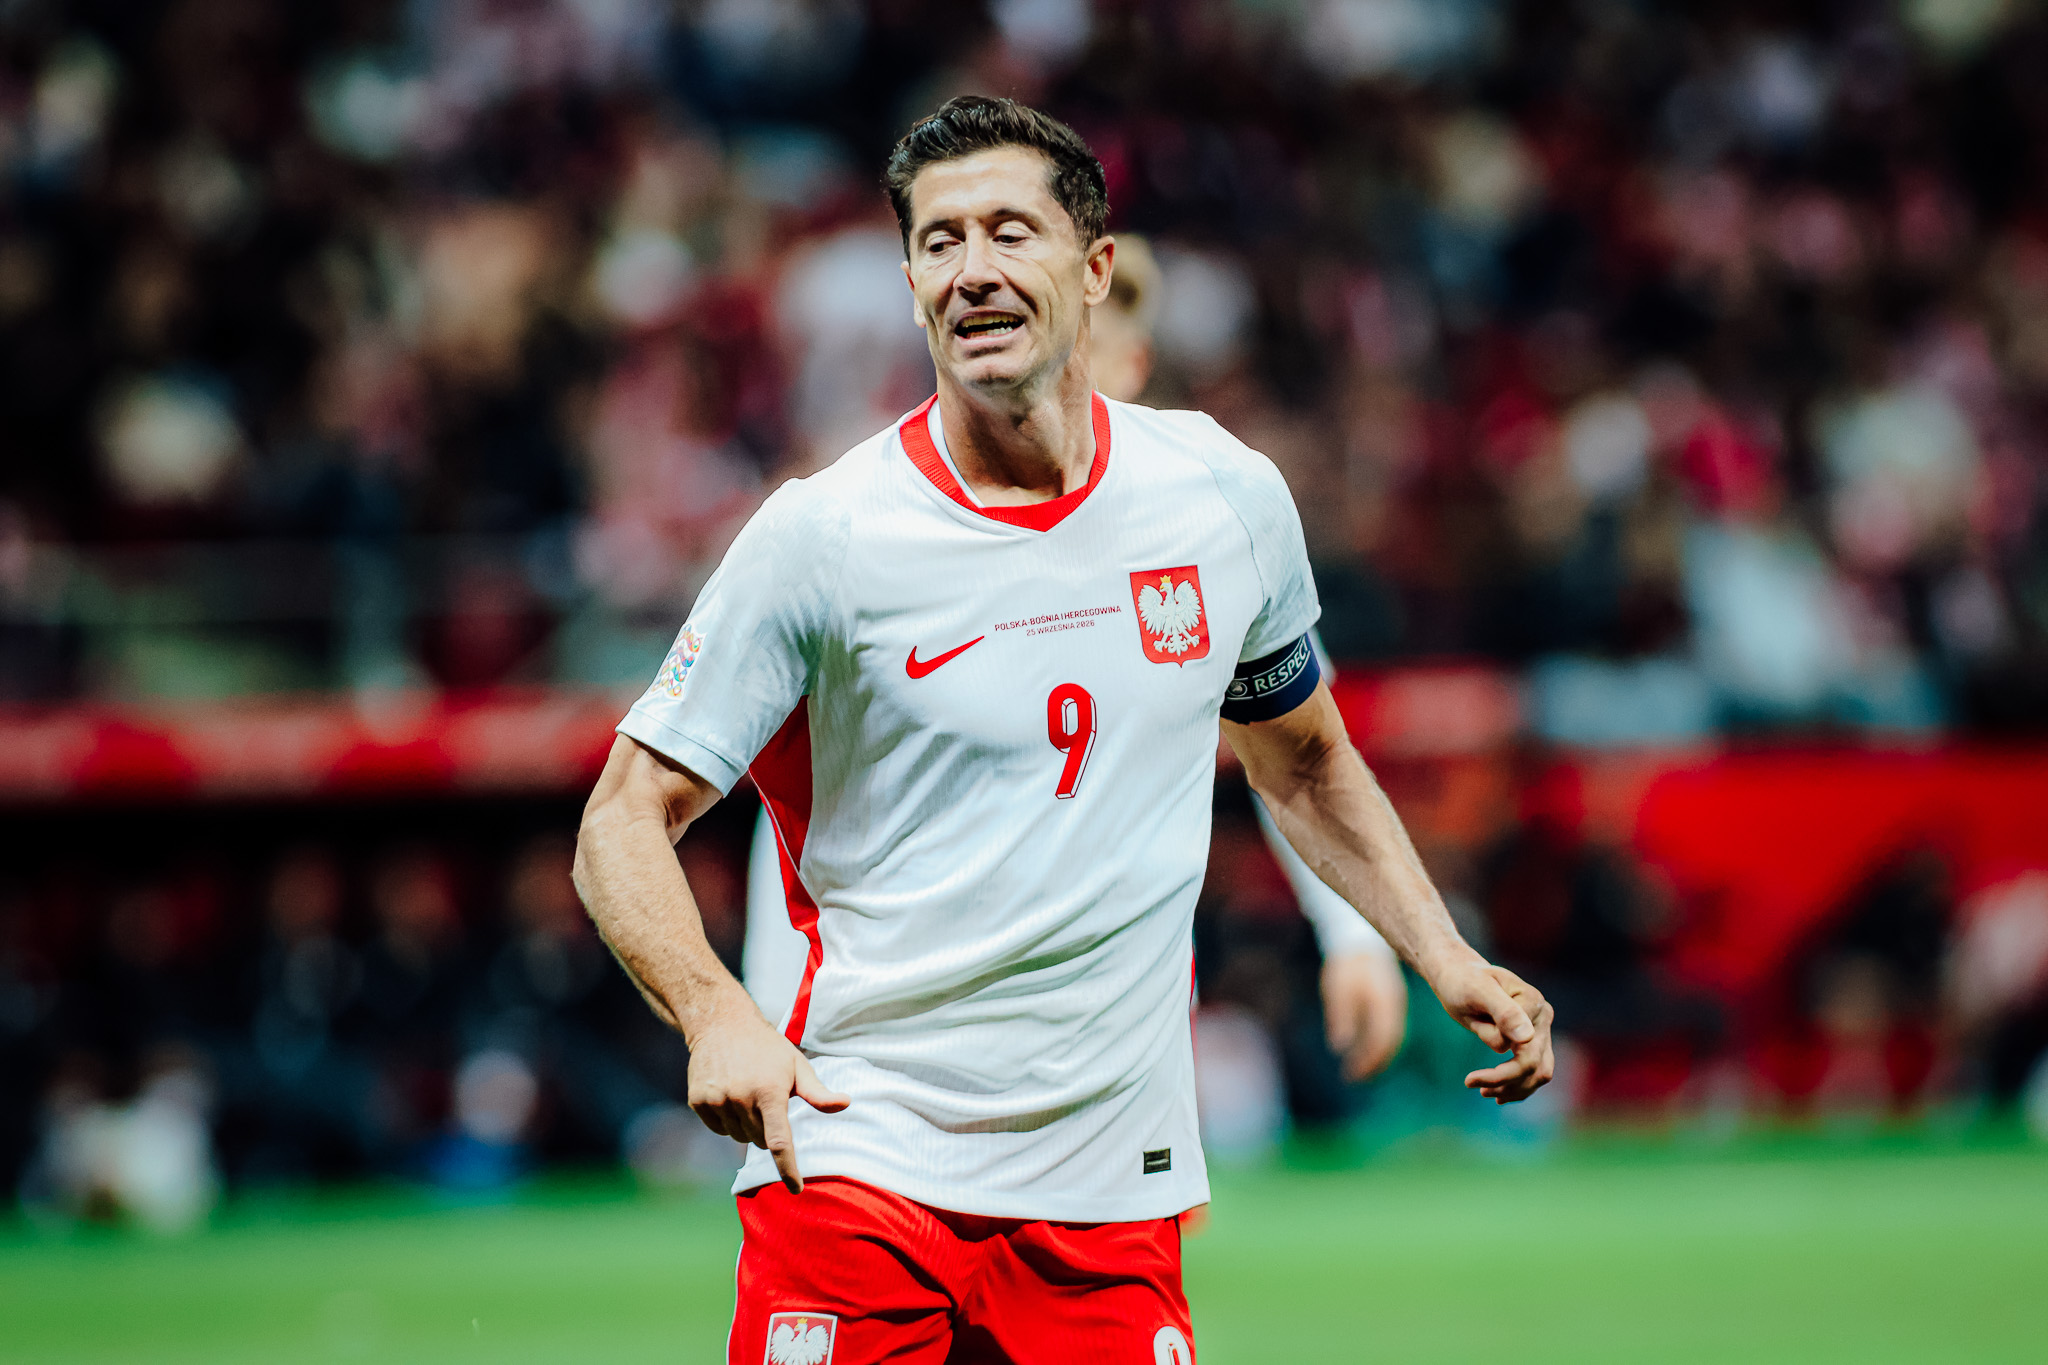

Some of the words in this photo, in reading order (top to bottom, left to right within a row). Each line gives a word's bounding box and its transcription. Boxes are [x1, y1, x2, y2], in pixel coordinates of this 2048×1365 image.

[1026, 628, 1036, 637] 25
[1076, 619, 1095, 629] 2026
[1064, 605, 1121, 619] HERCEGOWINA
[1254, 636, 1308, 692] RESPECT
[1047, 682, 1097, 800] 9
